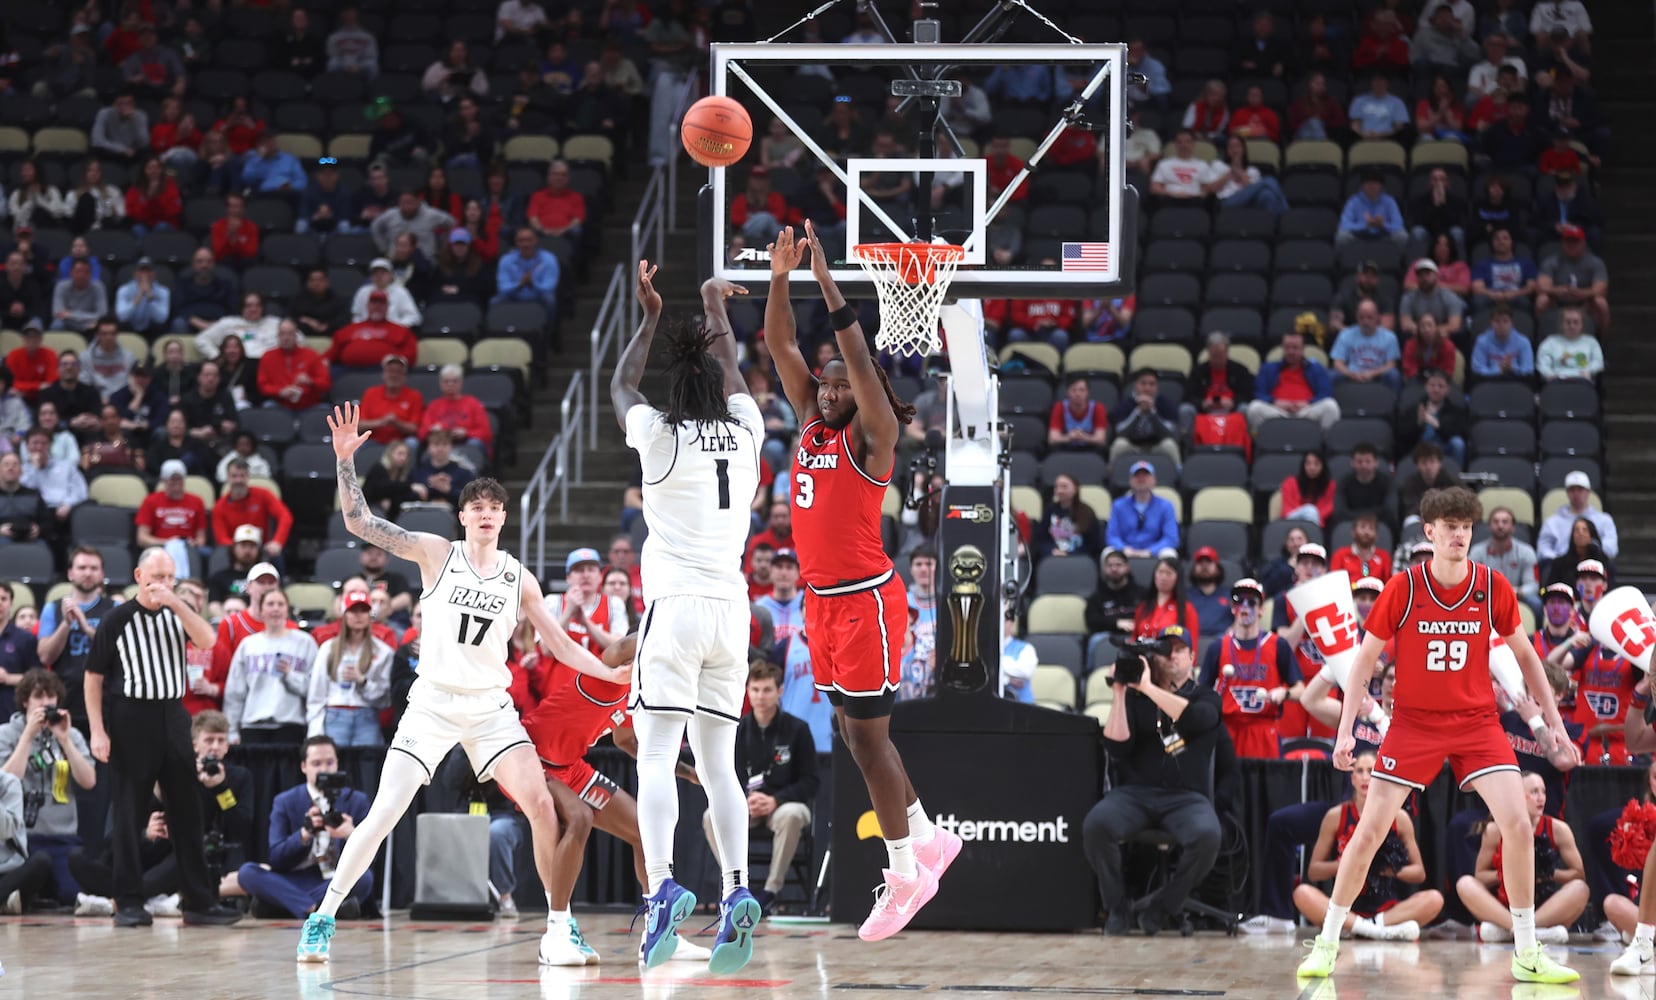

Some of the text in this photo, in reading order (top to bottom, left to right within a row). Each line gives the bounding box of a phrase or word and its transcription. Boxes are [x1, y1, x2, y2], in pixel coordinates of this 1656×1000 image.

[701, 436, 738, 452] LEWIS
[713, 459, 730, 510] 1
[795, 472, 815, 509] 3
[448, 585, 507, 615] RAMS
[457, 612, 494, 647] 17
[1417, 620, 1481, 635] DAYTON
[1425, 639, 1469, 672] 29
